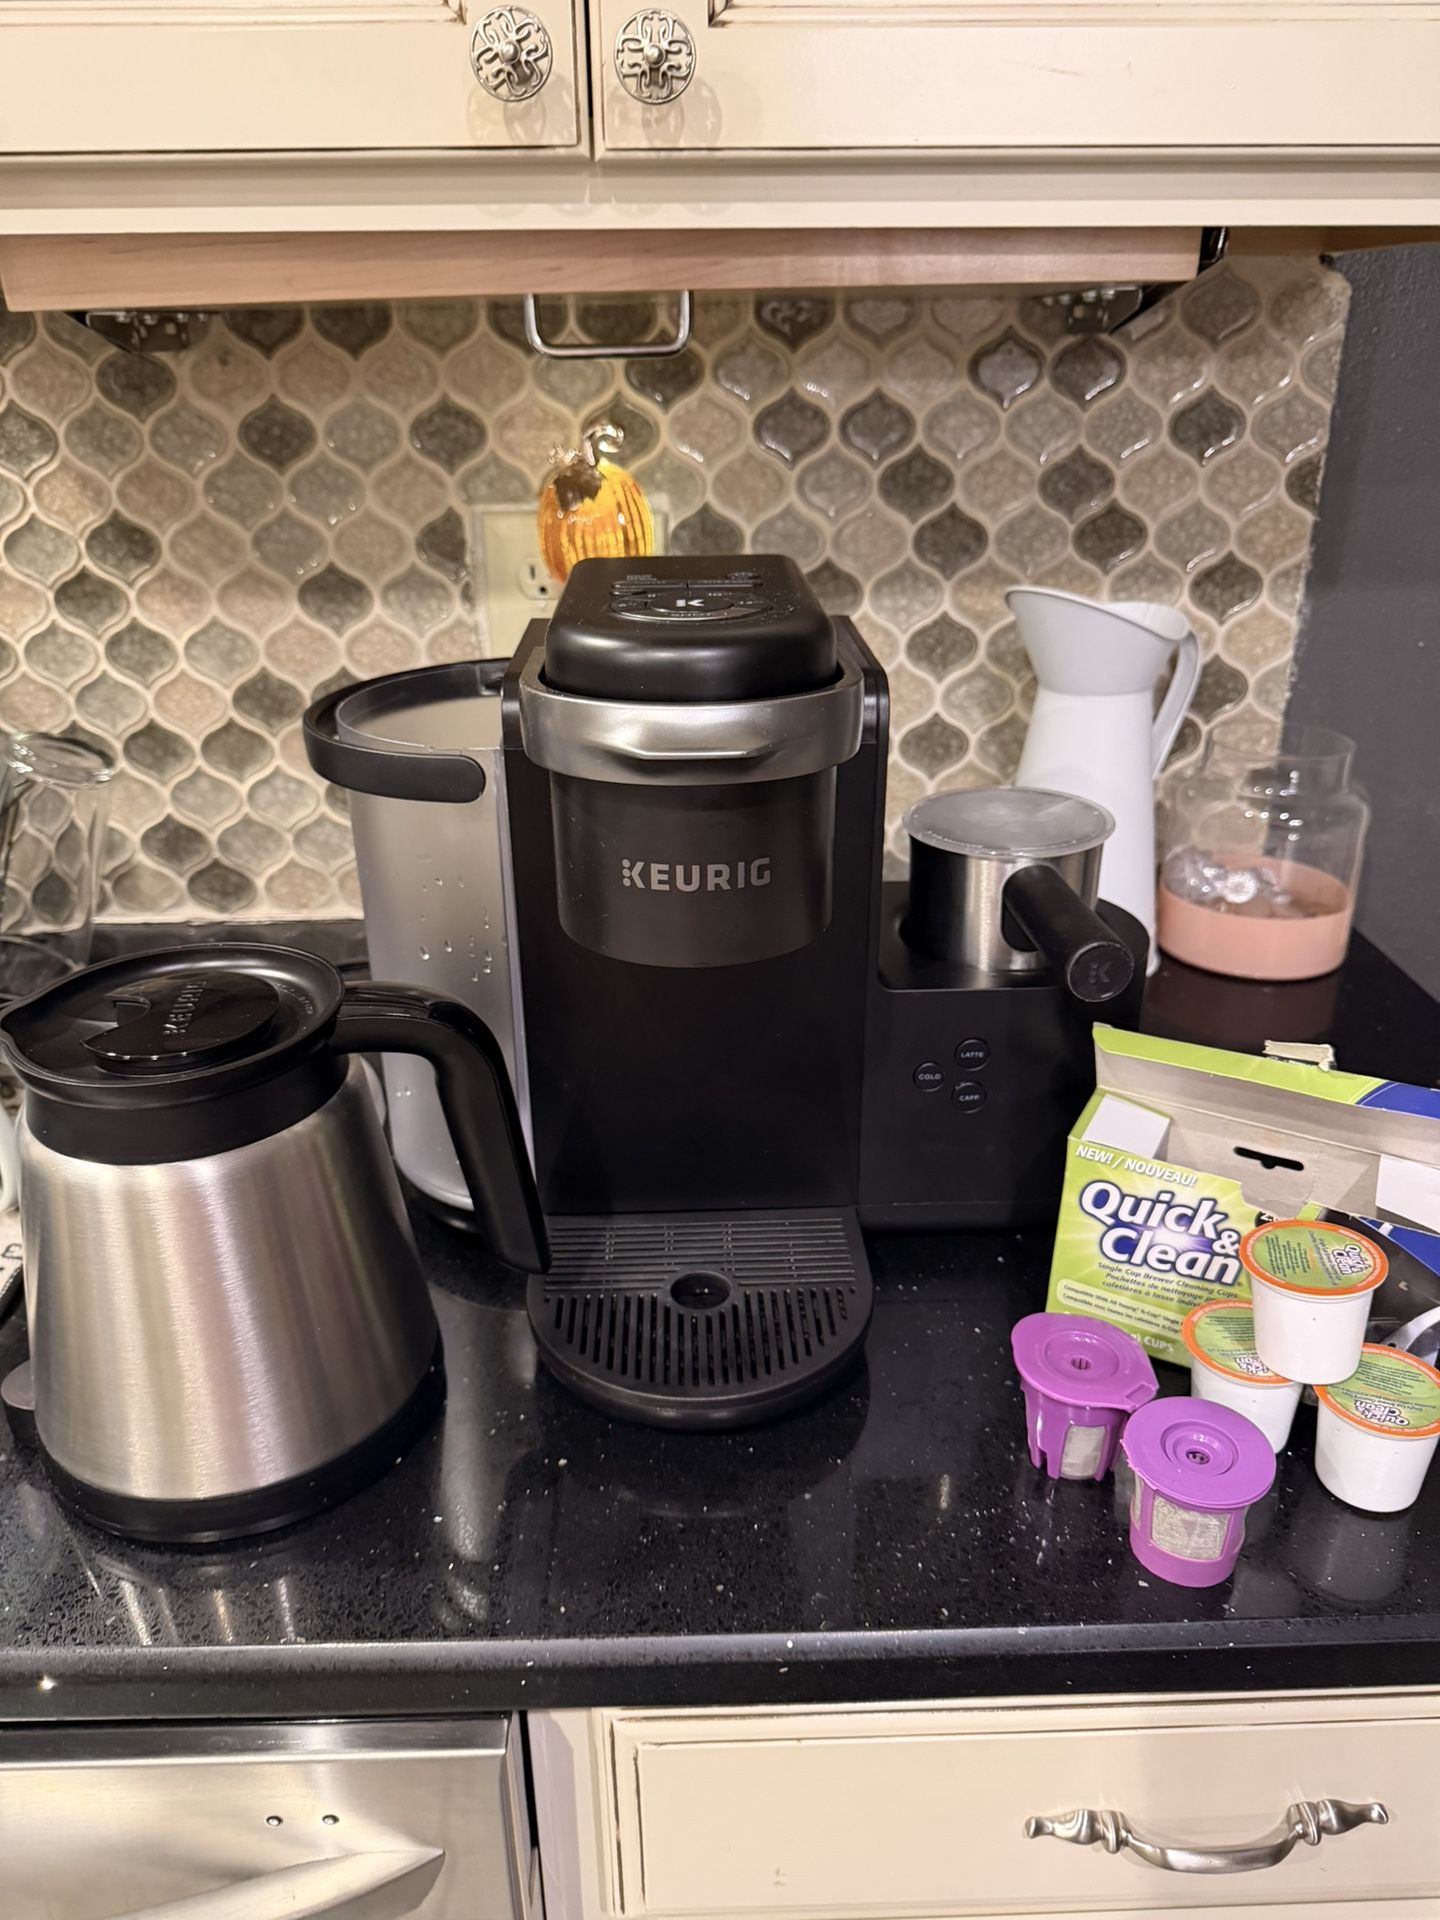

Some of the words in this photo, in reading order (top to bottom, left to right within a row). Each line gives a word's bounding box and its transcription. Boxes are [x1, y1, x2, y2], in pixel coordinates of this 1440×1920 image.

[622, 857, 771, 892] KEURIG
[961, 1051, 984, 1059] LATTE
[918, 1073, 941, 1081] COLD
[1075, 1145, 1115, 1165] NEW!
[1124, 1158, 1199, 1187] NOUVEAU!
[1080, 1180, 1228, 1239] Quick
[1212, 1229, 1241, 1256] &
[1100, 1226, 1243, 1287] Clean
[1098, 1262, 1123, 1273] Single
[1125, 1268, 1141, 1278] Cup
[1143, 1272, 1174, 1284] Brewer
[1176, 1280, 1214, 1295] Cleaning
[1217, 1289, 1238, 1298] Cups
[1105, 1272, 1145, 1287] Pochettes
[1144, 1336, 1174, 1352] CUPS
[1354, 1400, 1401, 1417] Clean
[1362, 1409, 1409, 1426] Quick
